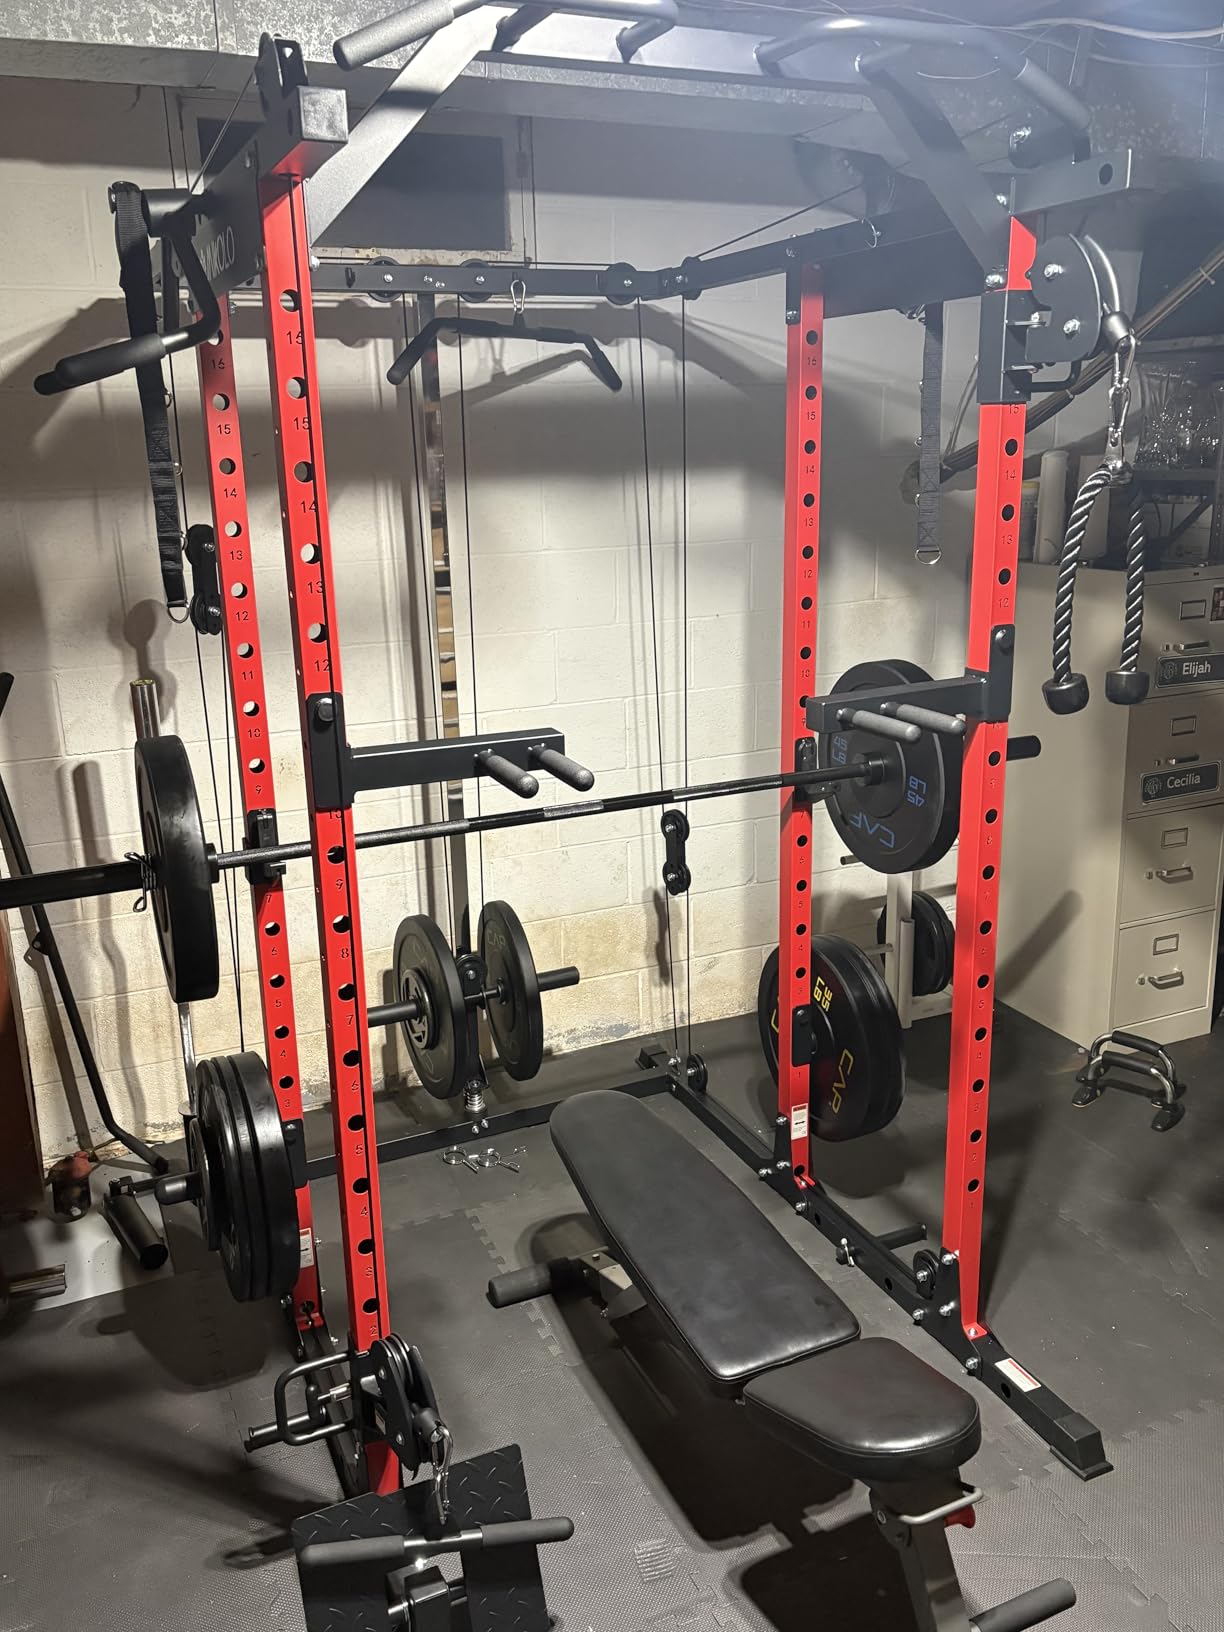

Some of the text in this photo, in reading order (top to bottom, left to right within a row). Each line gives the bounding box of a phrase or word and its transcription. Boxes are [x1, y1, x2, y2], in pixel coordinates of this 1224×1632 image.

[211, 359, 225, 370] 16
[807, 357, 816, 366] 16
[1009, 404, 1019, 414] 15
[806, 412, 816, 420] 15
[293, 417, 310, 430] 15
[217, 424, 231, 435] 15
[806, 465, 815, 474] 14
[1005, 470, 1016, 480] 14
[223, 488, 237, 498] 14
[301, 501, 317, 513] 14
[804, 518, 814, 527] 13
[1002, 535, 1012, 544] 13
[230, 550, 243, 560] 13
[803, 570, 812, 578] 12
[308, 582, 323, 594] 13
[999, 598, 1009, 608] 12
[236, 611, 249, 621] 12
[802, 620, 810, 628] 11
[314, 660, 330, 672] 12
[1182, 660, 1211, 678] Elijah
[242, 671, 254, 680] 11
[801, 669, 810, 678] 10
[248, 728, 260, 738] 10
[833, 736, 848, 751] 45
[832, 748, 847, 764] LB
[909, 775, 926, 794] LB
[1166, 772, 1200, 789] Cecilia
[255, 785, 261, 794] 9
[907, 791, 925, 808] 45
[336, 879, 343, 889] 9
[266, 894, 272, 903] 7
[272, 947, 277, 956] 6
[341, 948, 349, 958] 8
[814, 976, 825, 1001] LB
[275, 999, 282, 1008] 5
[821, 986, 833, 1012] 35
[978, 1000, 984, 1008] 5
[346, 1014, 354, 1025] 7
[280, 1049, 286, 1057] 4
[352, 1080, 359, 1090] 6
[832, 1048, 854, 1114] CAP
[355, 1144, 363, 1155] 5
[361, 1206, 368, 1216] 4
[366, 1266, 373, 1277] 3
[370, 1325, 377, 1335] 2
